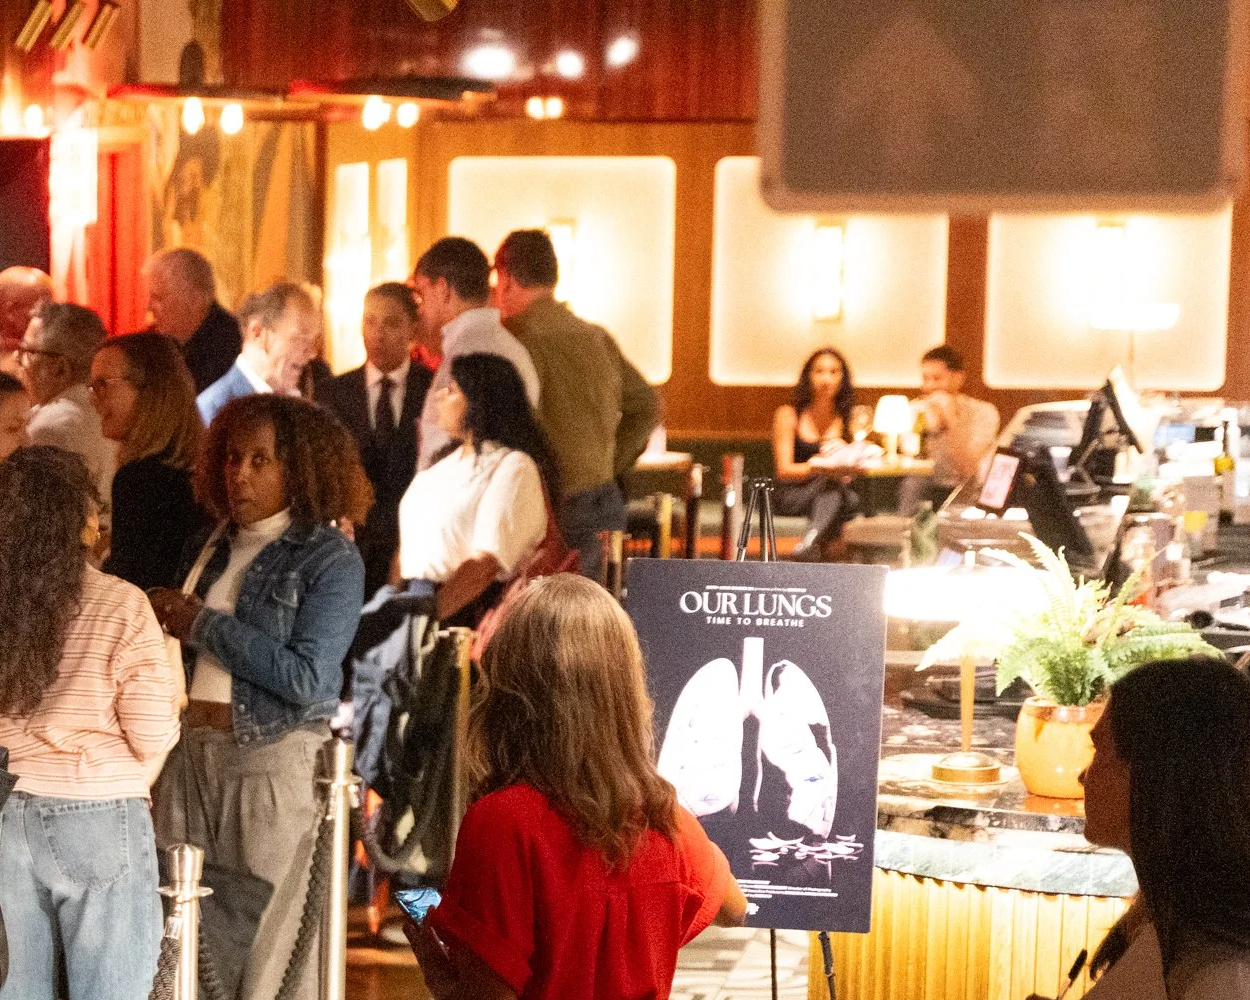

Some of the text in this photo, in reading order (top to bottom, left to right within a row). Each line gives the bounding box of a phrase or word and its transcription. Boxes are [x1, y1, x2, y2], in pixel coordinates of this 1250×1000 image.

[679, 590, 833, 618] OUR LUNGS
[706, 616, 805, 627] TIME TO BREATHE
